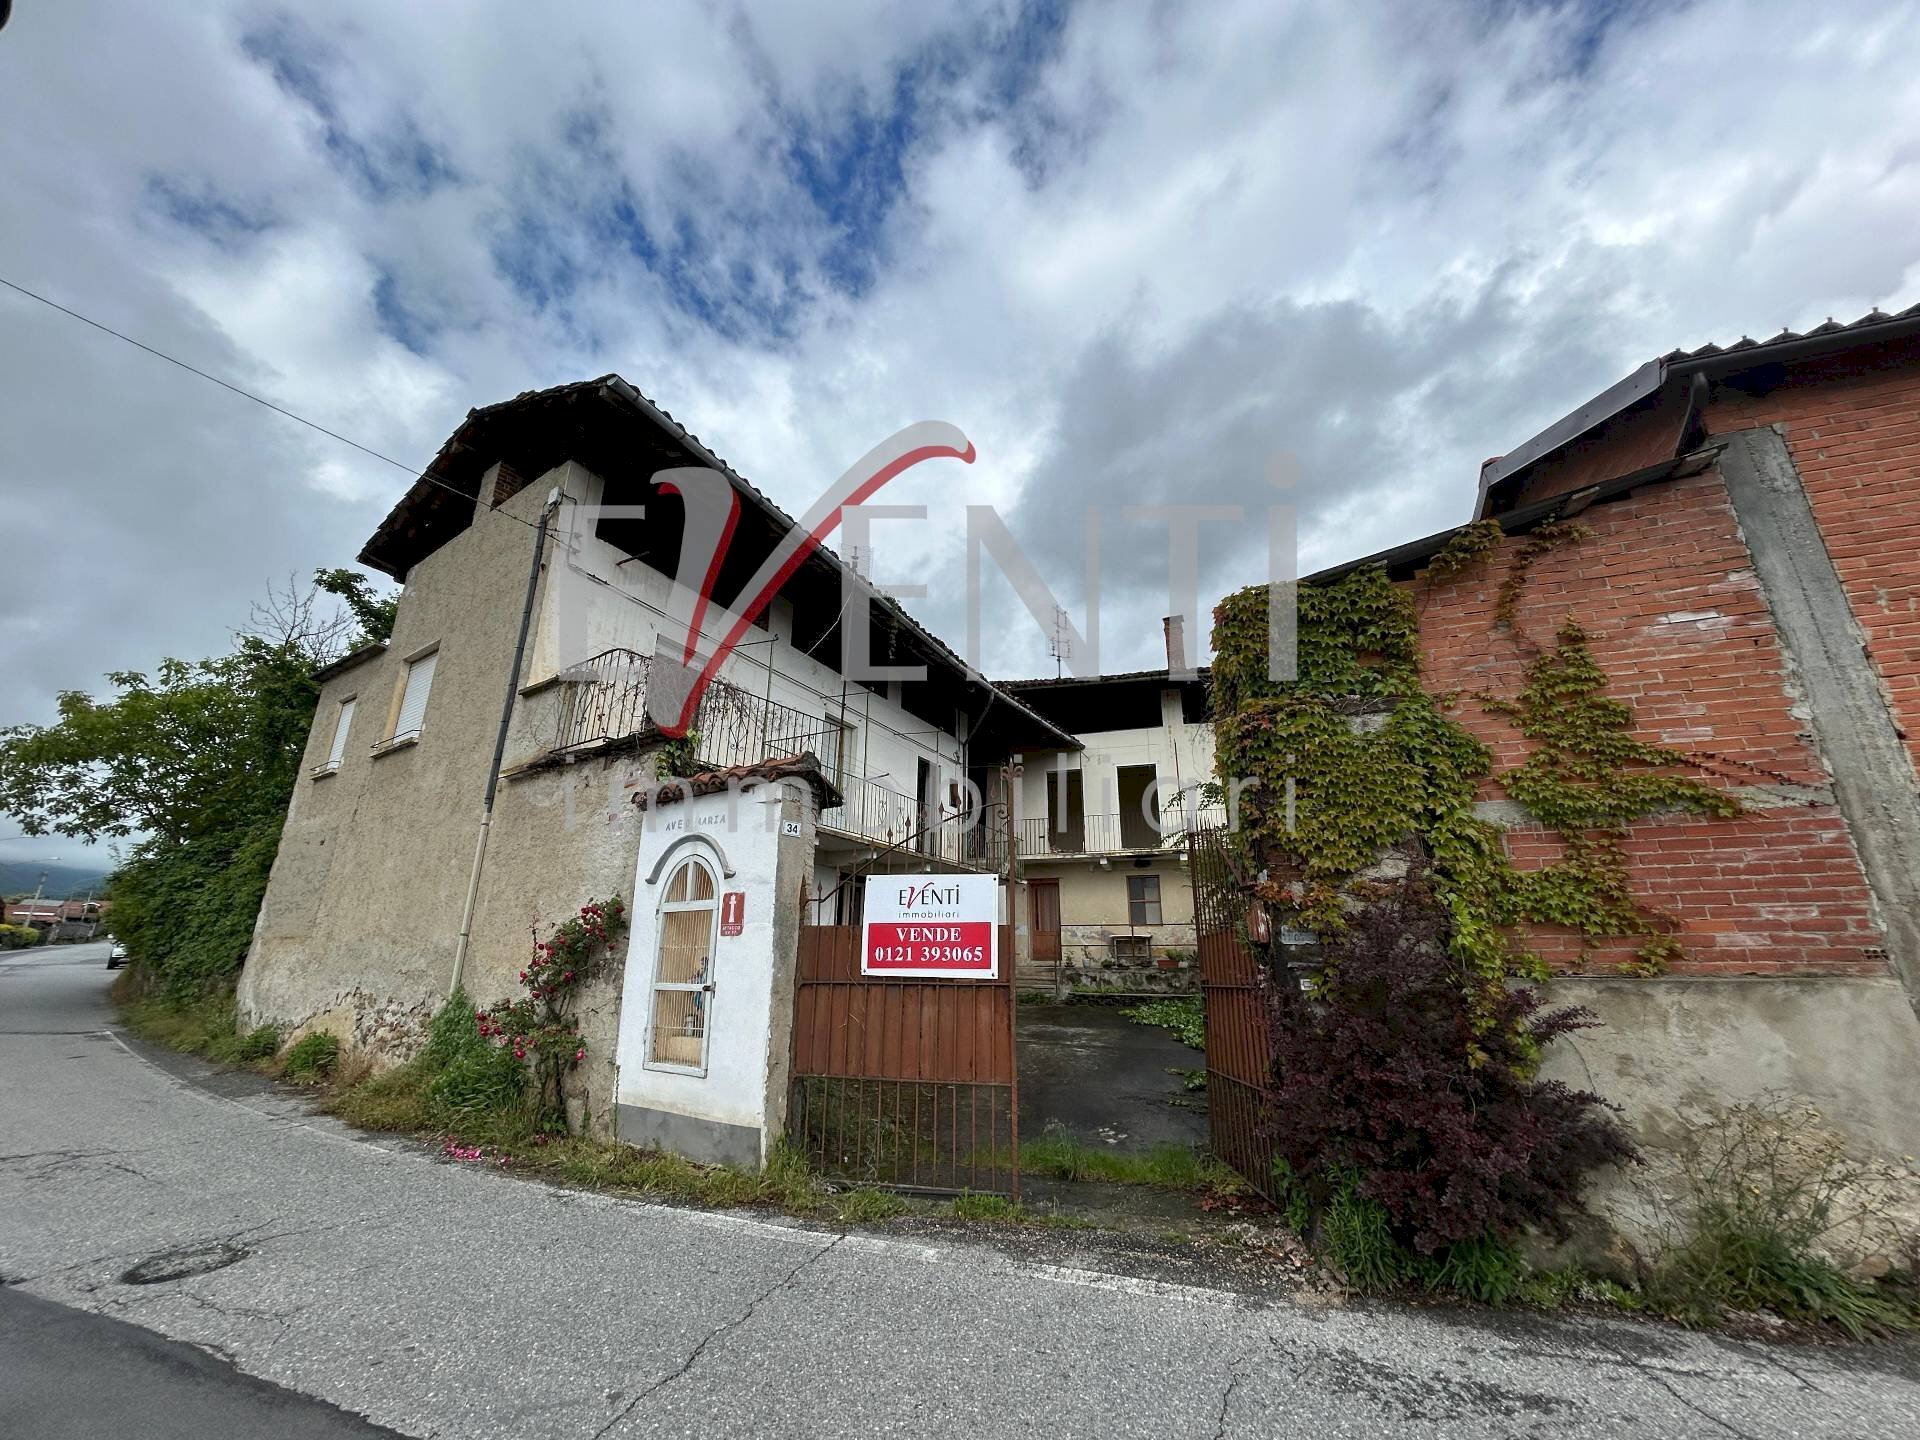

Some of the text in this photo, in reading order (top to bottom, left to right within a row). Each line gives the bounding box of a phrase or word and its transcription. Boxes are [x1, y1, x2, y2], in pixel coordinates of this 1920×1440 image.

[665, 819, 683, 831] AVE
[787, 823, 798, 834] 34
[898, 910, 960, 919] immobiliari
[896, 927, 962, 942] VENDE
[875, 946, 984, 962] 0121 393065
